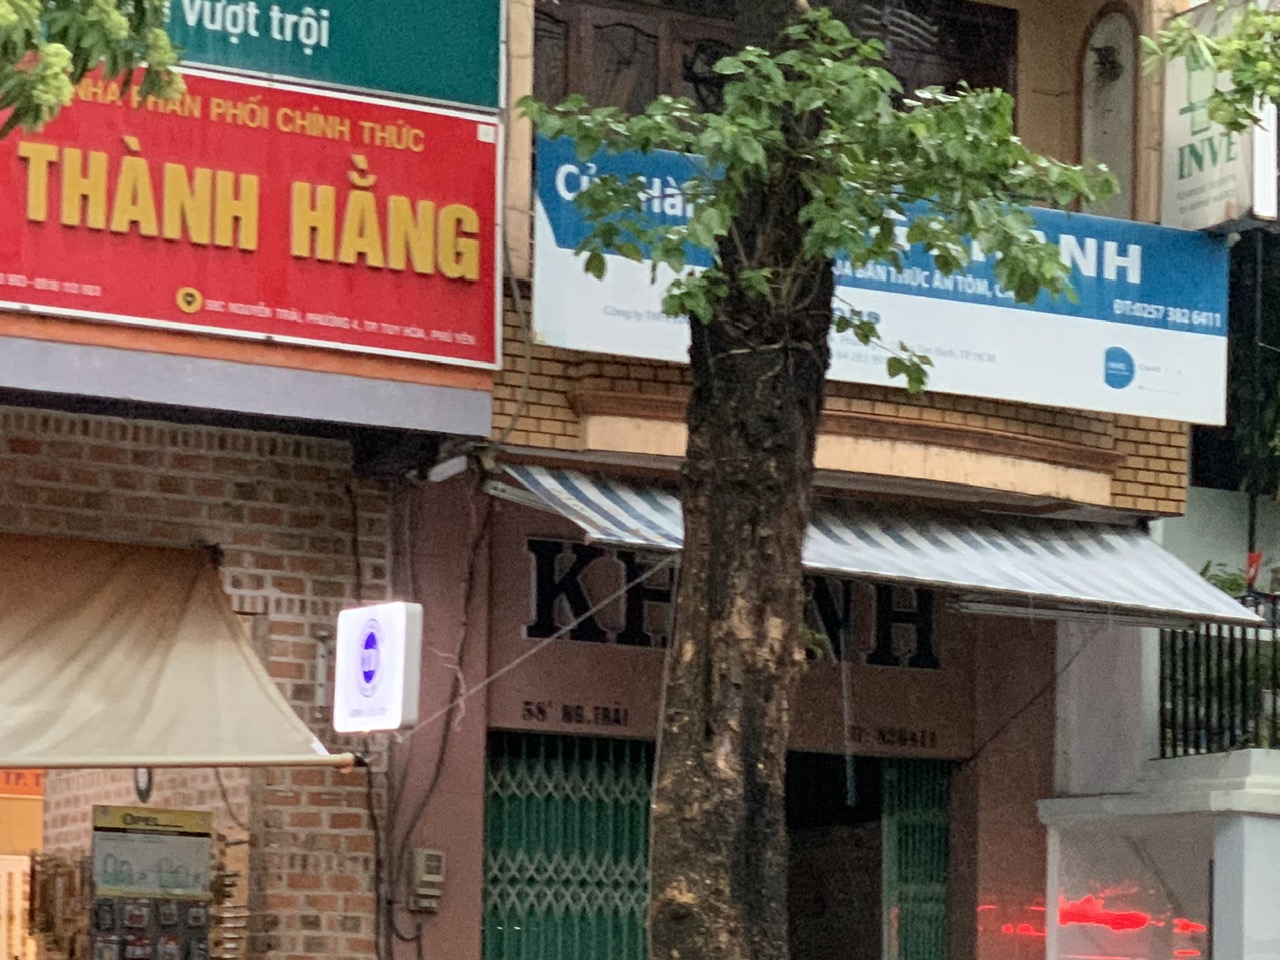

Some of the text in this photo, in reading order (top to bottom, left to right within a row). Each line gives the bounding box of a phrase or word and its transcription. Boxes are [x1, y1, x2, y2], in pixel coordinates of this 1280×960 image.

[269, 5, 330, 55] trội
[209, 95, 270, 129] PHỐI
[276, 106, 350, 141] CHÍNH
[358, 119, 425, 152] THỨC
[17, 135, 481, 282] THÀNH HẰNG
[526, 537, 941, 670] KHNH
